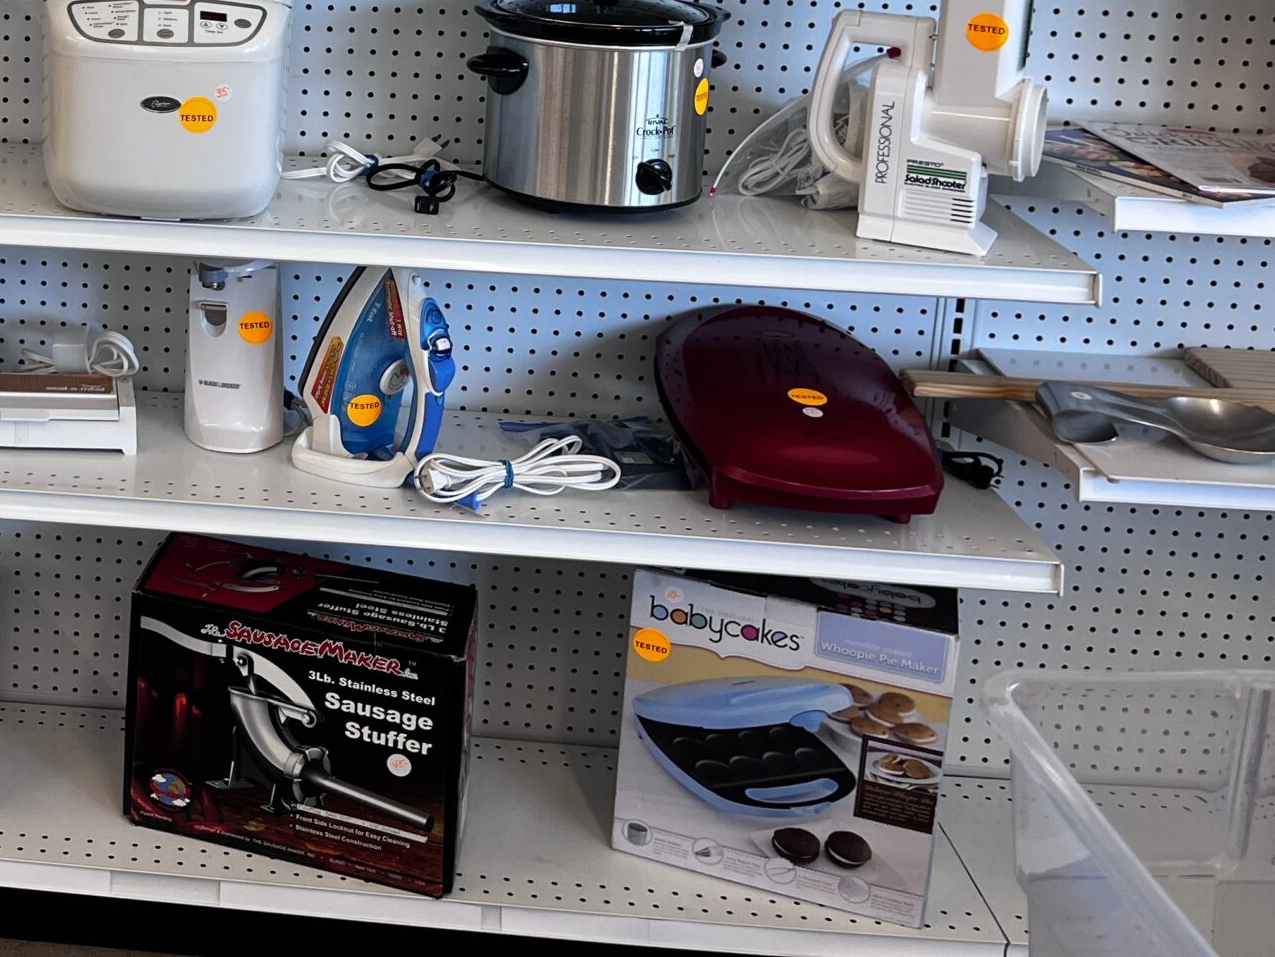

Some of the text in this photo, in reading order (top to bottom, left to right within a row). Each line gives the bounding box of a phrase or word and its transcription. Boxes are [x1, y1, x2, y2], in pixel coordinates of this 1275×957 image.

[968, 23, 1006, 35] TESTED
[180, 114, 214, 122] TESTED
[875, 101, 895, 184] PROFESSIONAL
[904, 174, 967, 190] SaladShooter
[239, 321, 270, 329] TESTED
[350, 402, 380, 410] TESTED
[317, 602, 359, 616] Stuffer
[355, 602, 388, 614] Steel
[391, 610, 449, 627] Stainless
[649, 596, 801, 651] babycakes
[225, 620, 318, 656] SAUSAGE
[316, 639, 401, 675] MAKER
[635, 640, 667, 655] TESTED
[821, 640, 940, 675] Whoopie Pie Maker
[308, 670, 436, 706] 3Lb. Stainless Steel
[324, 691, 434, 731] Sausage
[344, 721, 433, 755] Stuffer
[295, 813, 310, 823] Front
[311, 817, 327, 827] Side
[355, 829, 364, 837] for
[365, 831, 381, 842] Easy
[382, 835, 410, 849] Cleaning
[295, 824, 382, 852] Stainless Steel Construction
